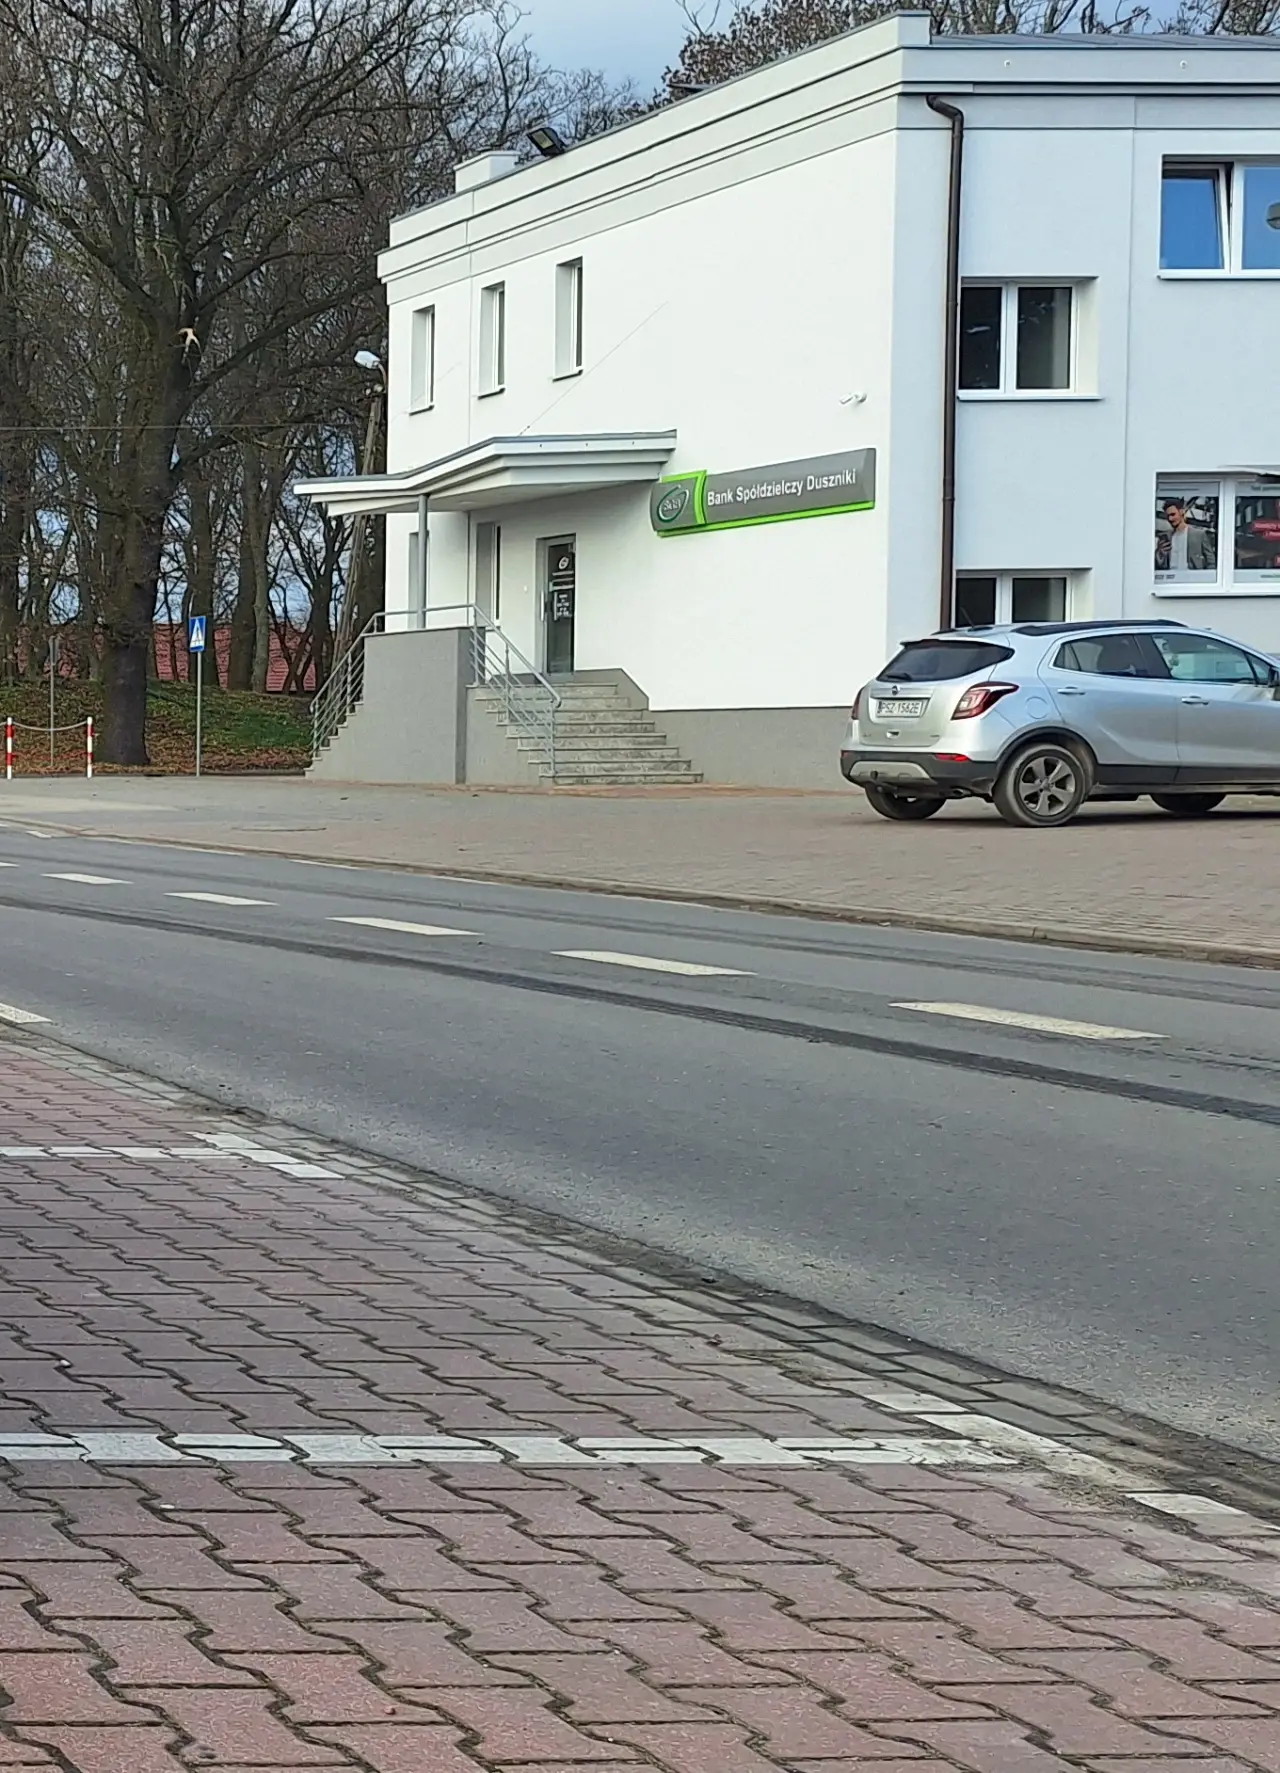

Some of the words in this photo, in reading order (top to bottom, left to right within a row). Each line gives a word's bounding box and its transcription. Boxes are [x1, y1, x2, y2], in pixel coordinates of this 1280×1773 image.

[707, 488, 734, 506] Bank
[736, 479, 803, 504] Spółdzielczy
[806, 468, 856, 490] Duszniki
